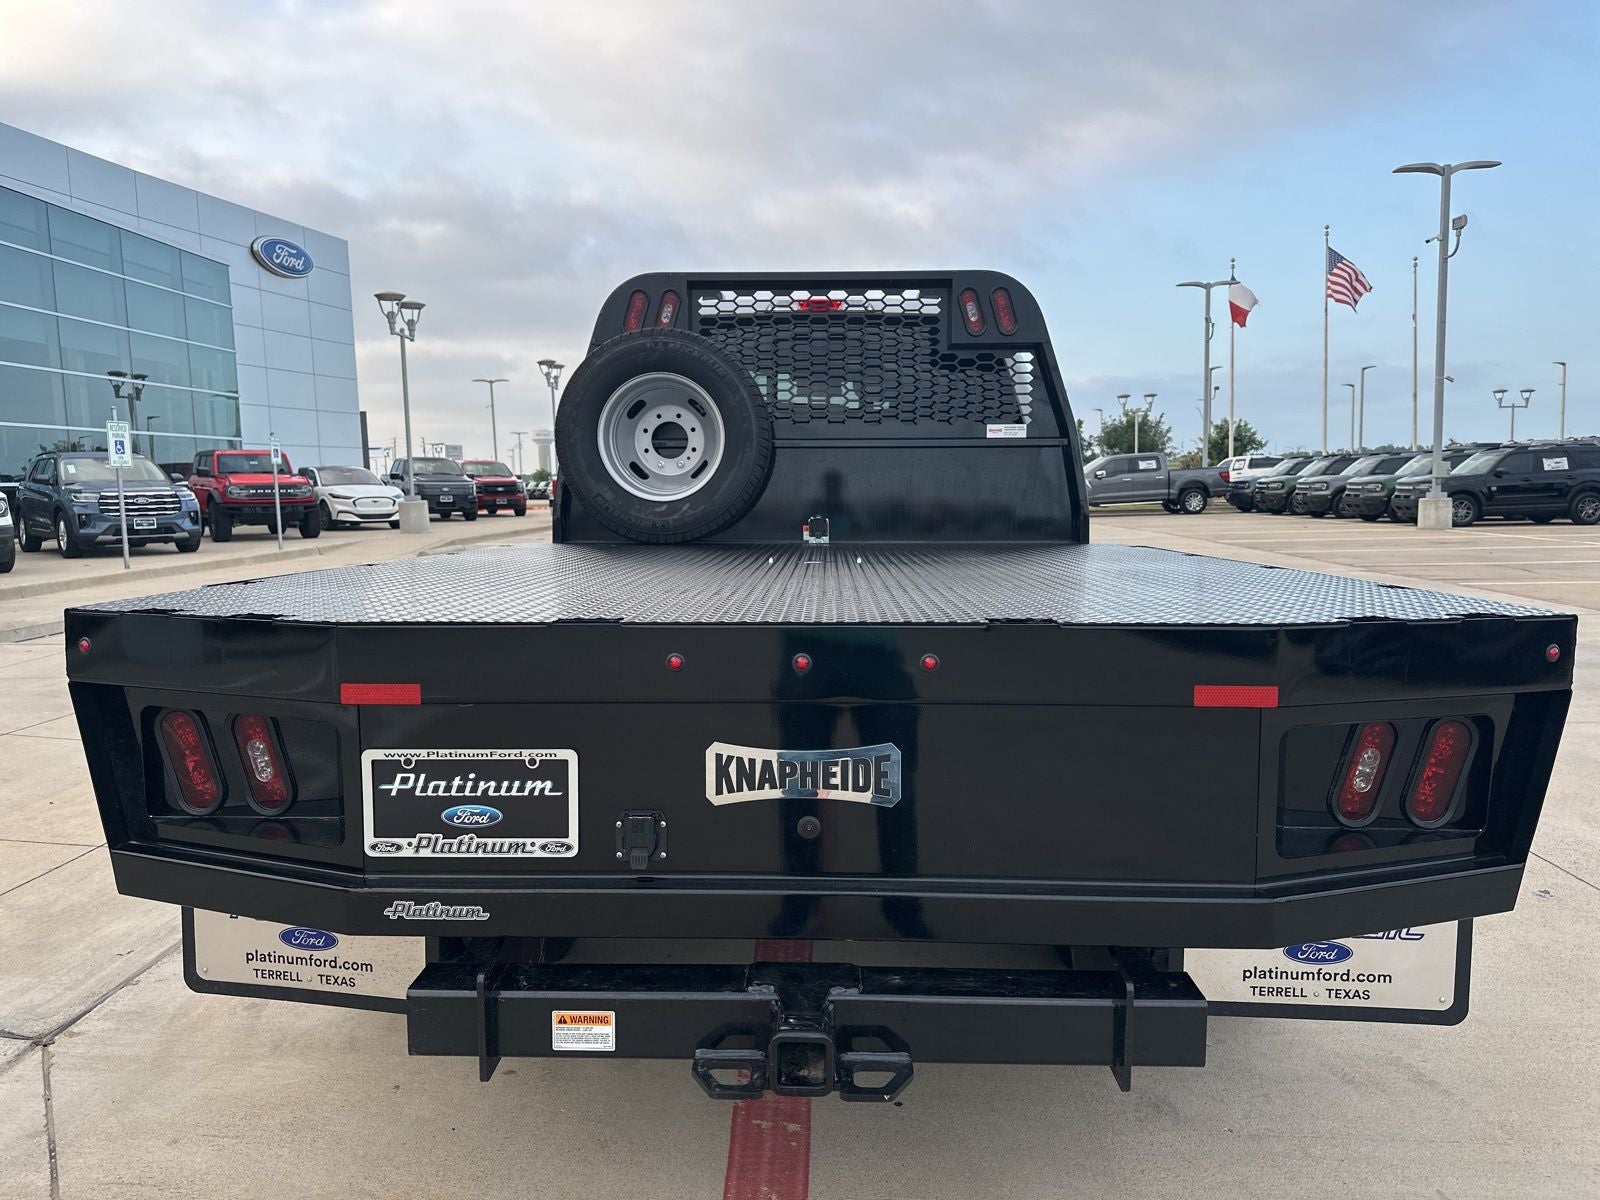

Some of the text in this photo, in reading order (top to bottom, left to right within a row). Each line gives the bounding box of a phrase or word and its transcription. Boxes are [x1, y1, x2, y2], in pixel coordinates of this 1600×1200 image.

[273, 244, 304, 270] Ford
[383, 750, 558, 759] www.PlatinumFord.com
[378, 773, 563, 796] Platinum
[715, 753, 891, 798] KNAPHEIDE
[453, 809, 490, 824] Ford
[375, 836, 568, 854] Ford Platinum Ford
[385, 901, 489, 920] Platinum
[291, 929, 325, 946] Ford
[1297, 943, 1337, 960] Ford
[246, 950, 373, 972] platinumford.com
[253, 968, 356, 988] TERRELL TEXAS
[1242, 966, 1392, 984] platinumford.com
[1250, 985, 1370, 1000] TERRELL TEXAS
[570, 1015, 609, 1025] WARNING
